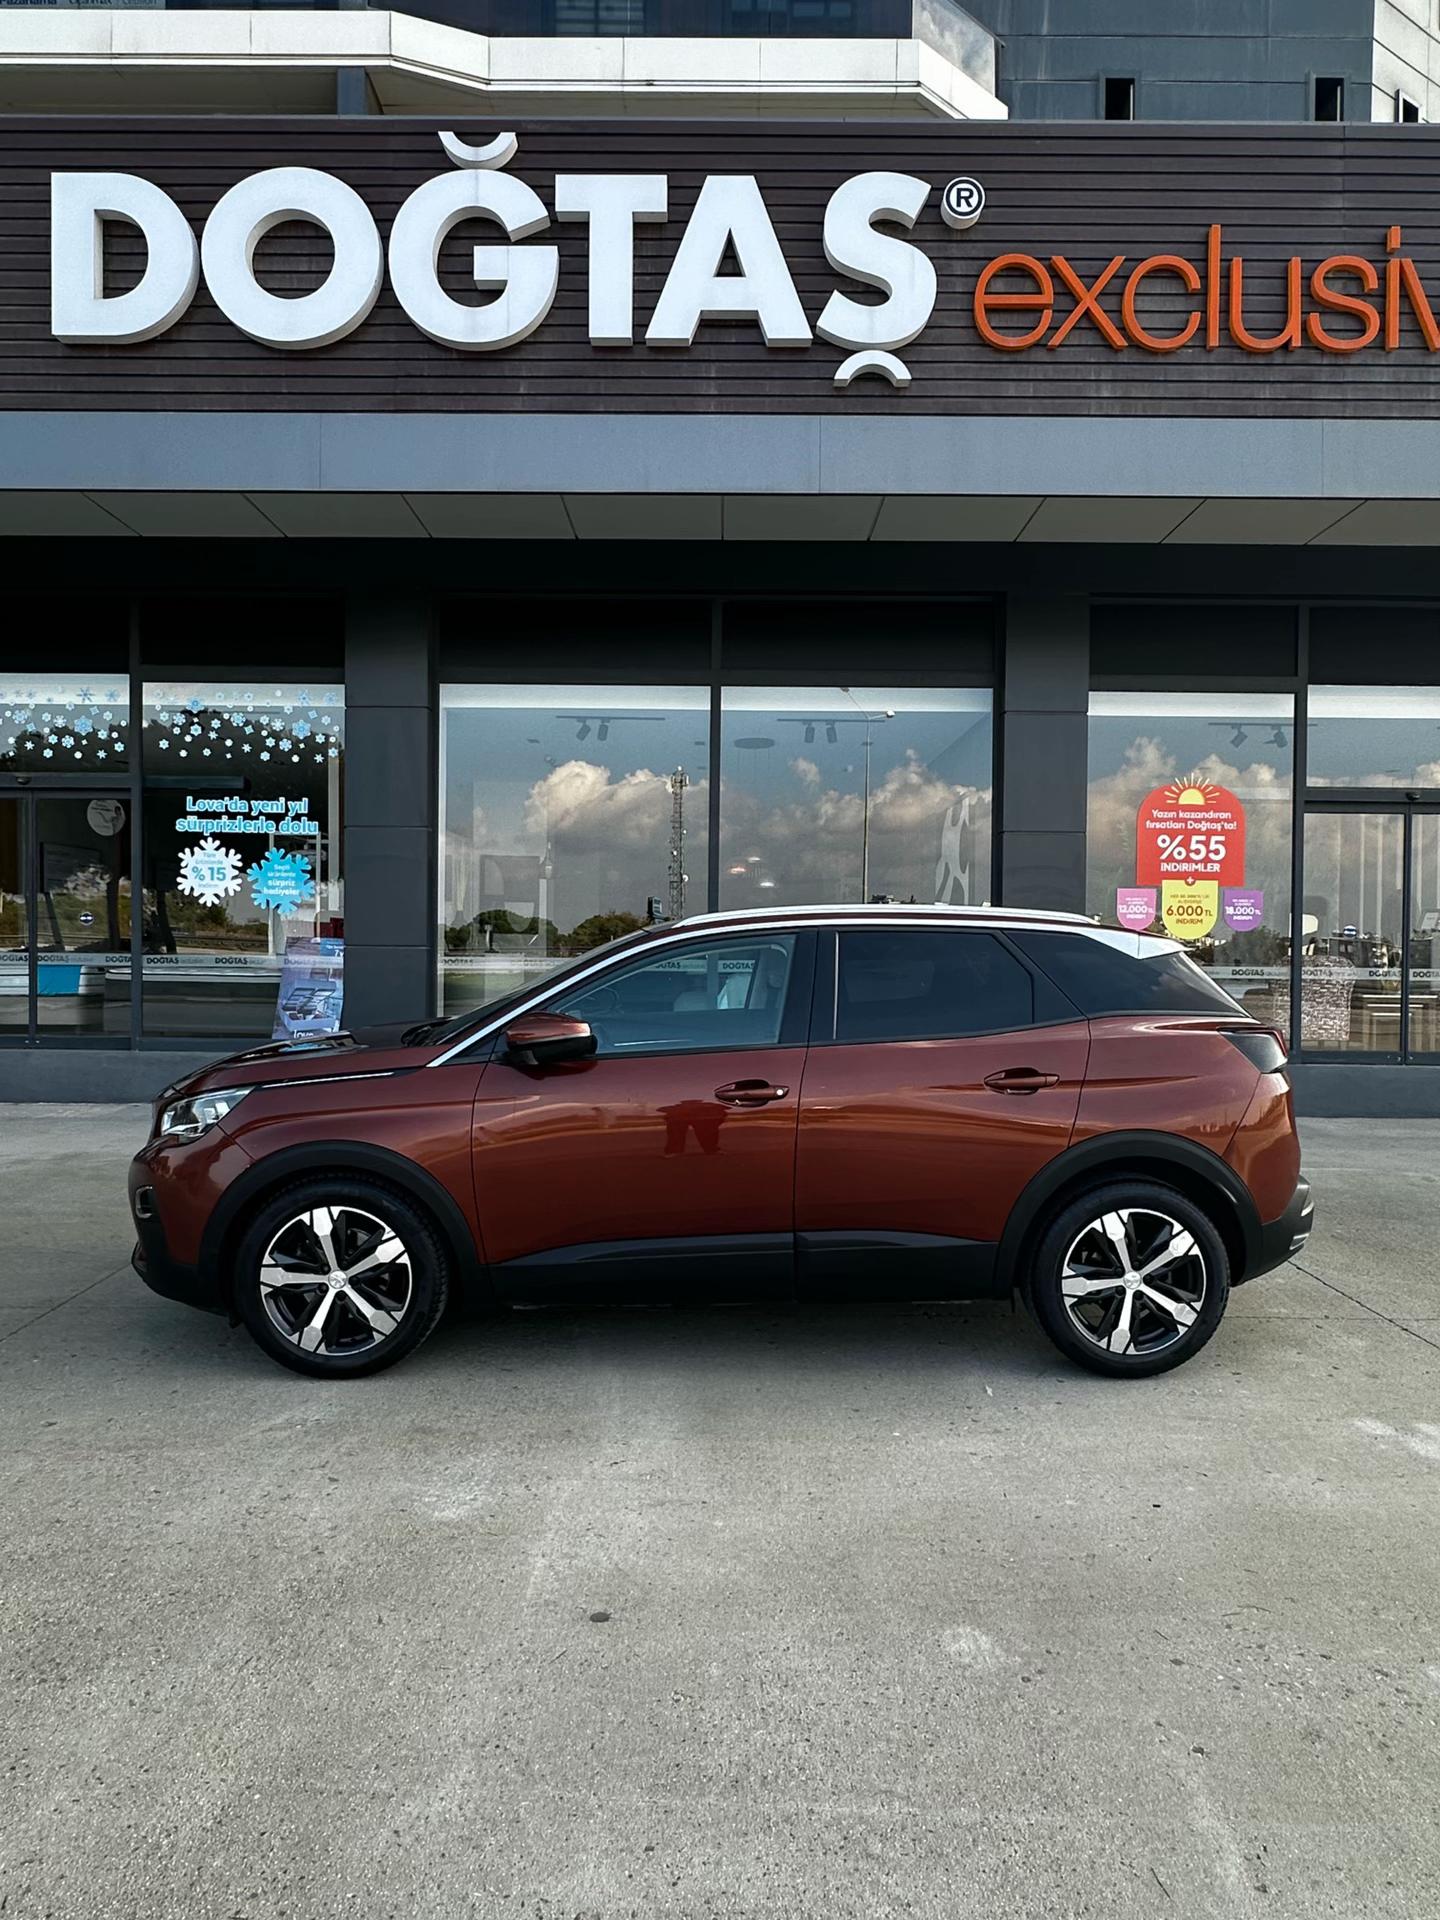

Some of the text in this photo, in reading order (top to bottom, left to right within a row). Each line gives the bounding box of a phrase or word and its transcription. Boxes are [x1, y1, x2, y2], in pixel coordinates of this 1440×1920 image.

[51, 131, 938, 389] DOĞTAŞ
[186, 796, 309, 817] Lova'da yeni yıl
[1152, 809, 1232, 819] Yazın kazandıran
[176, 815, 319, 836] sürprizlerle dolu
[1157, 834, 1227, 861] %55
[1166, 905, 1213, 917] 6.000 TL
